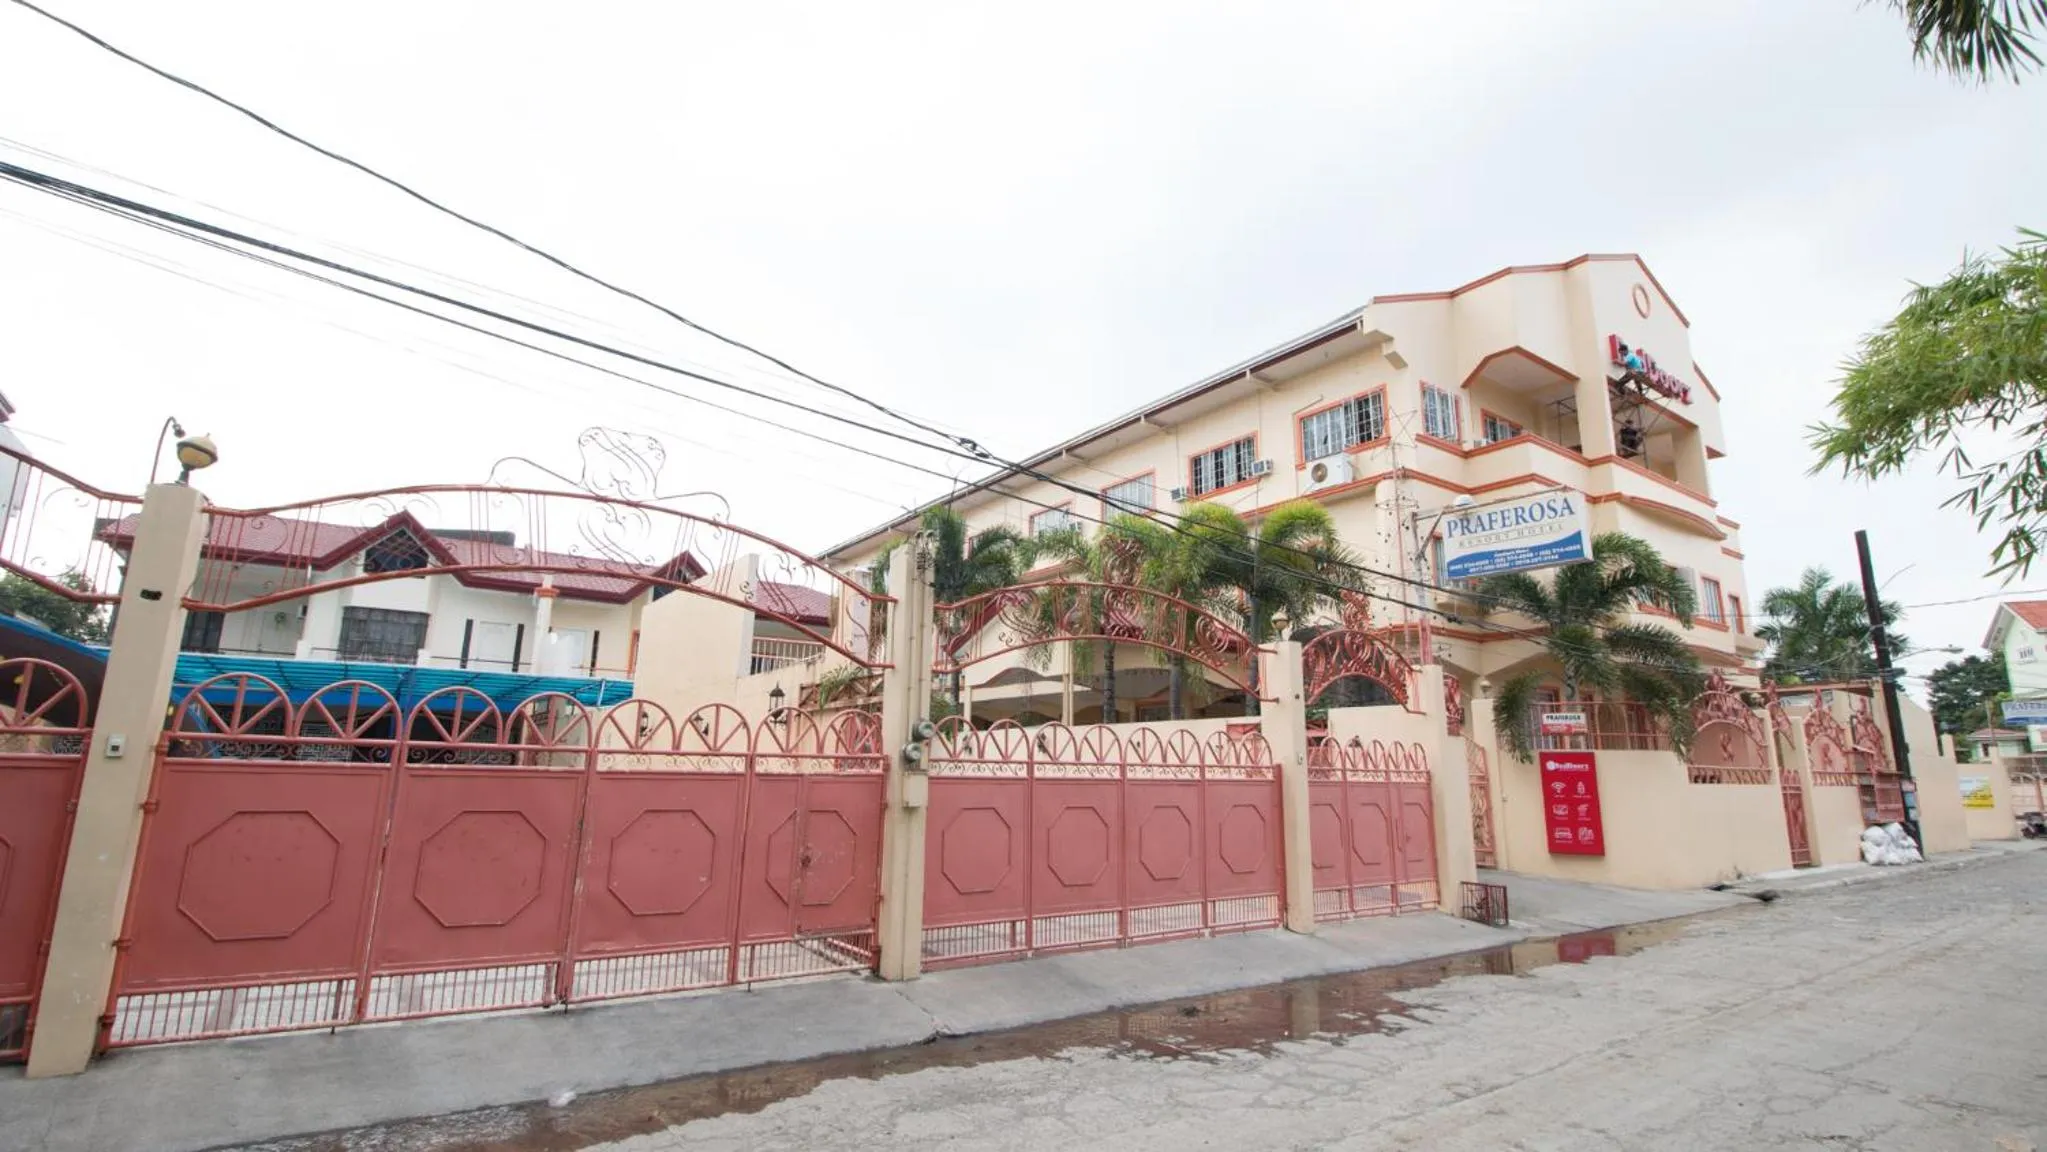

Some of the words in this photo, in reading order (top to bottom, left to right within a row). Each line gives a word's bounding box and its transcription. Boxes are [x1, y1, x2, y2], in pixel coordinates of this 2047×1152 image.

[1447, 497, 1575, 539] PRAFEROSA
[1458, 530, 1510, 548] RESORT
[1517, 523, 1563, 537] HOTEL
